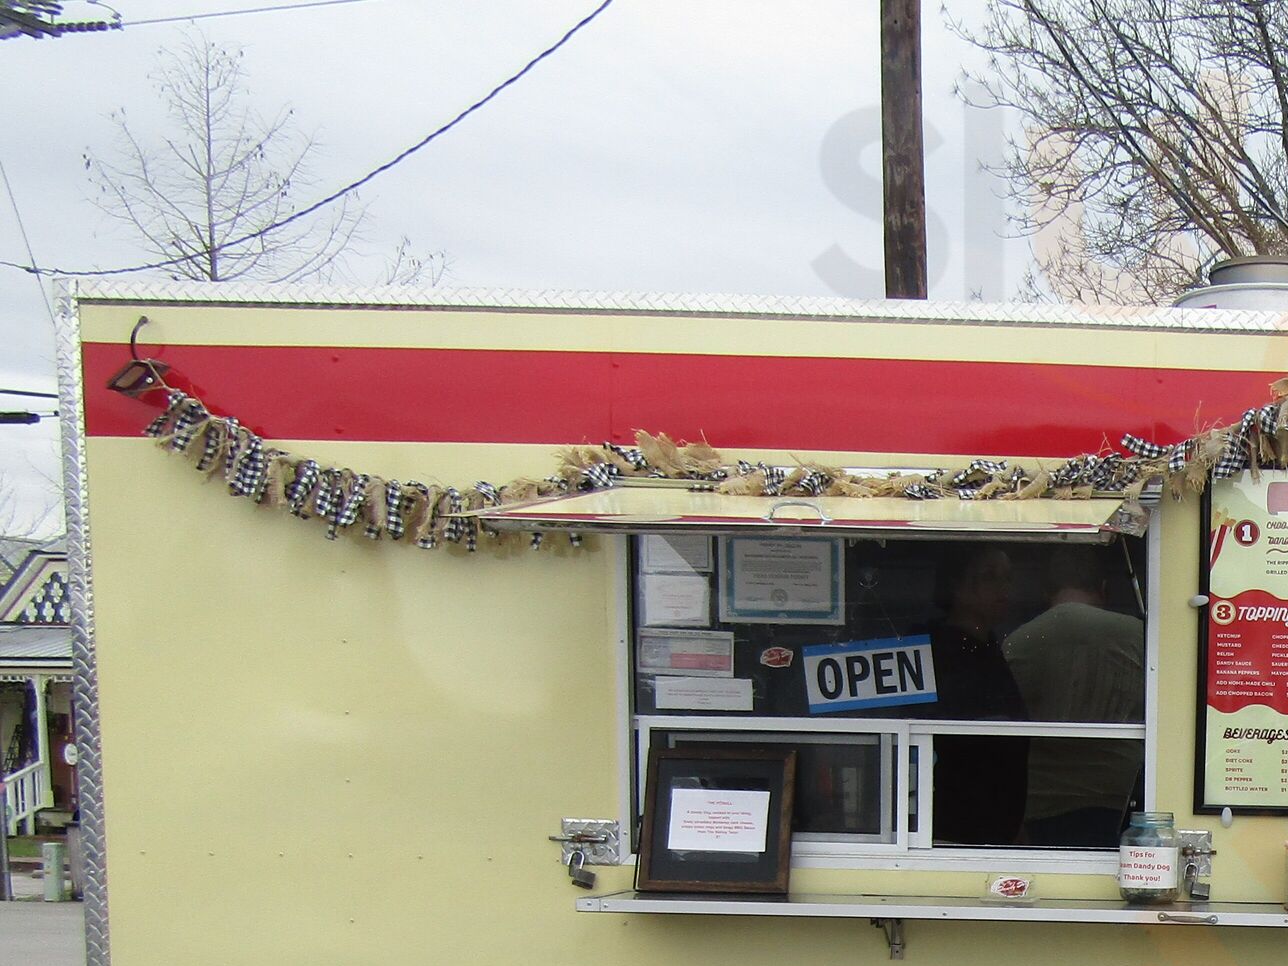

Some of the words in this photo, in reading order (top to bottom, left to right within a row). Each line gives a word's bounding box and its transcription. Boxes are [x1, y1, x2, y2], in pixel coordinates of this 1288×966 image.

[1241, 524, 1253, 542] 1
[1216, 604, 1231, 620] 3
[816, 649, 925, 700] OPEN
